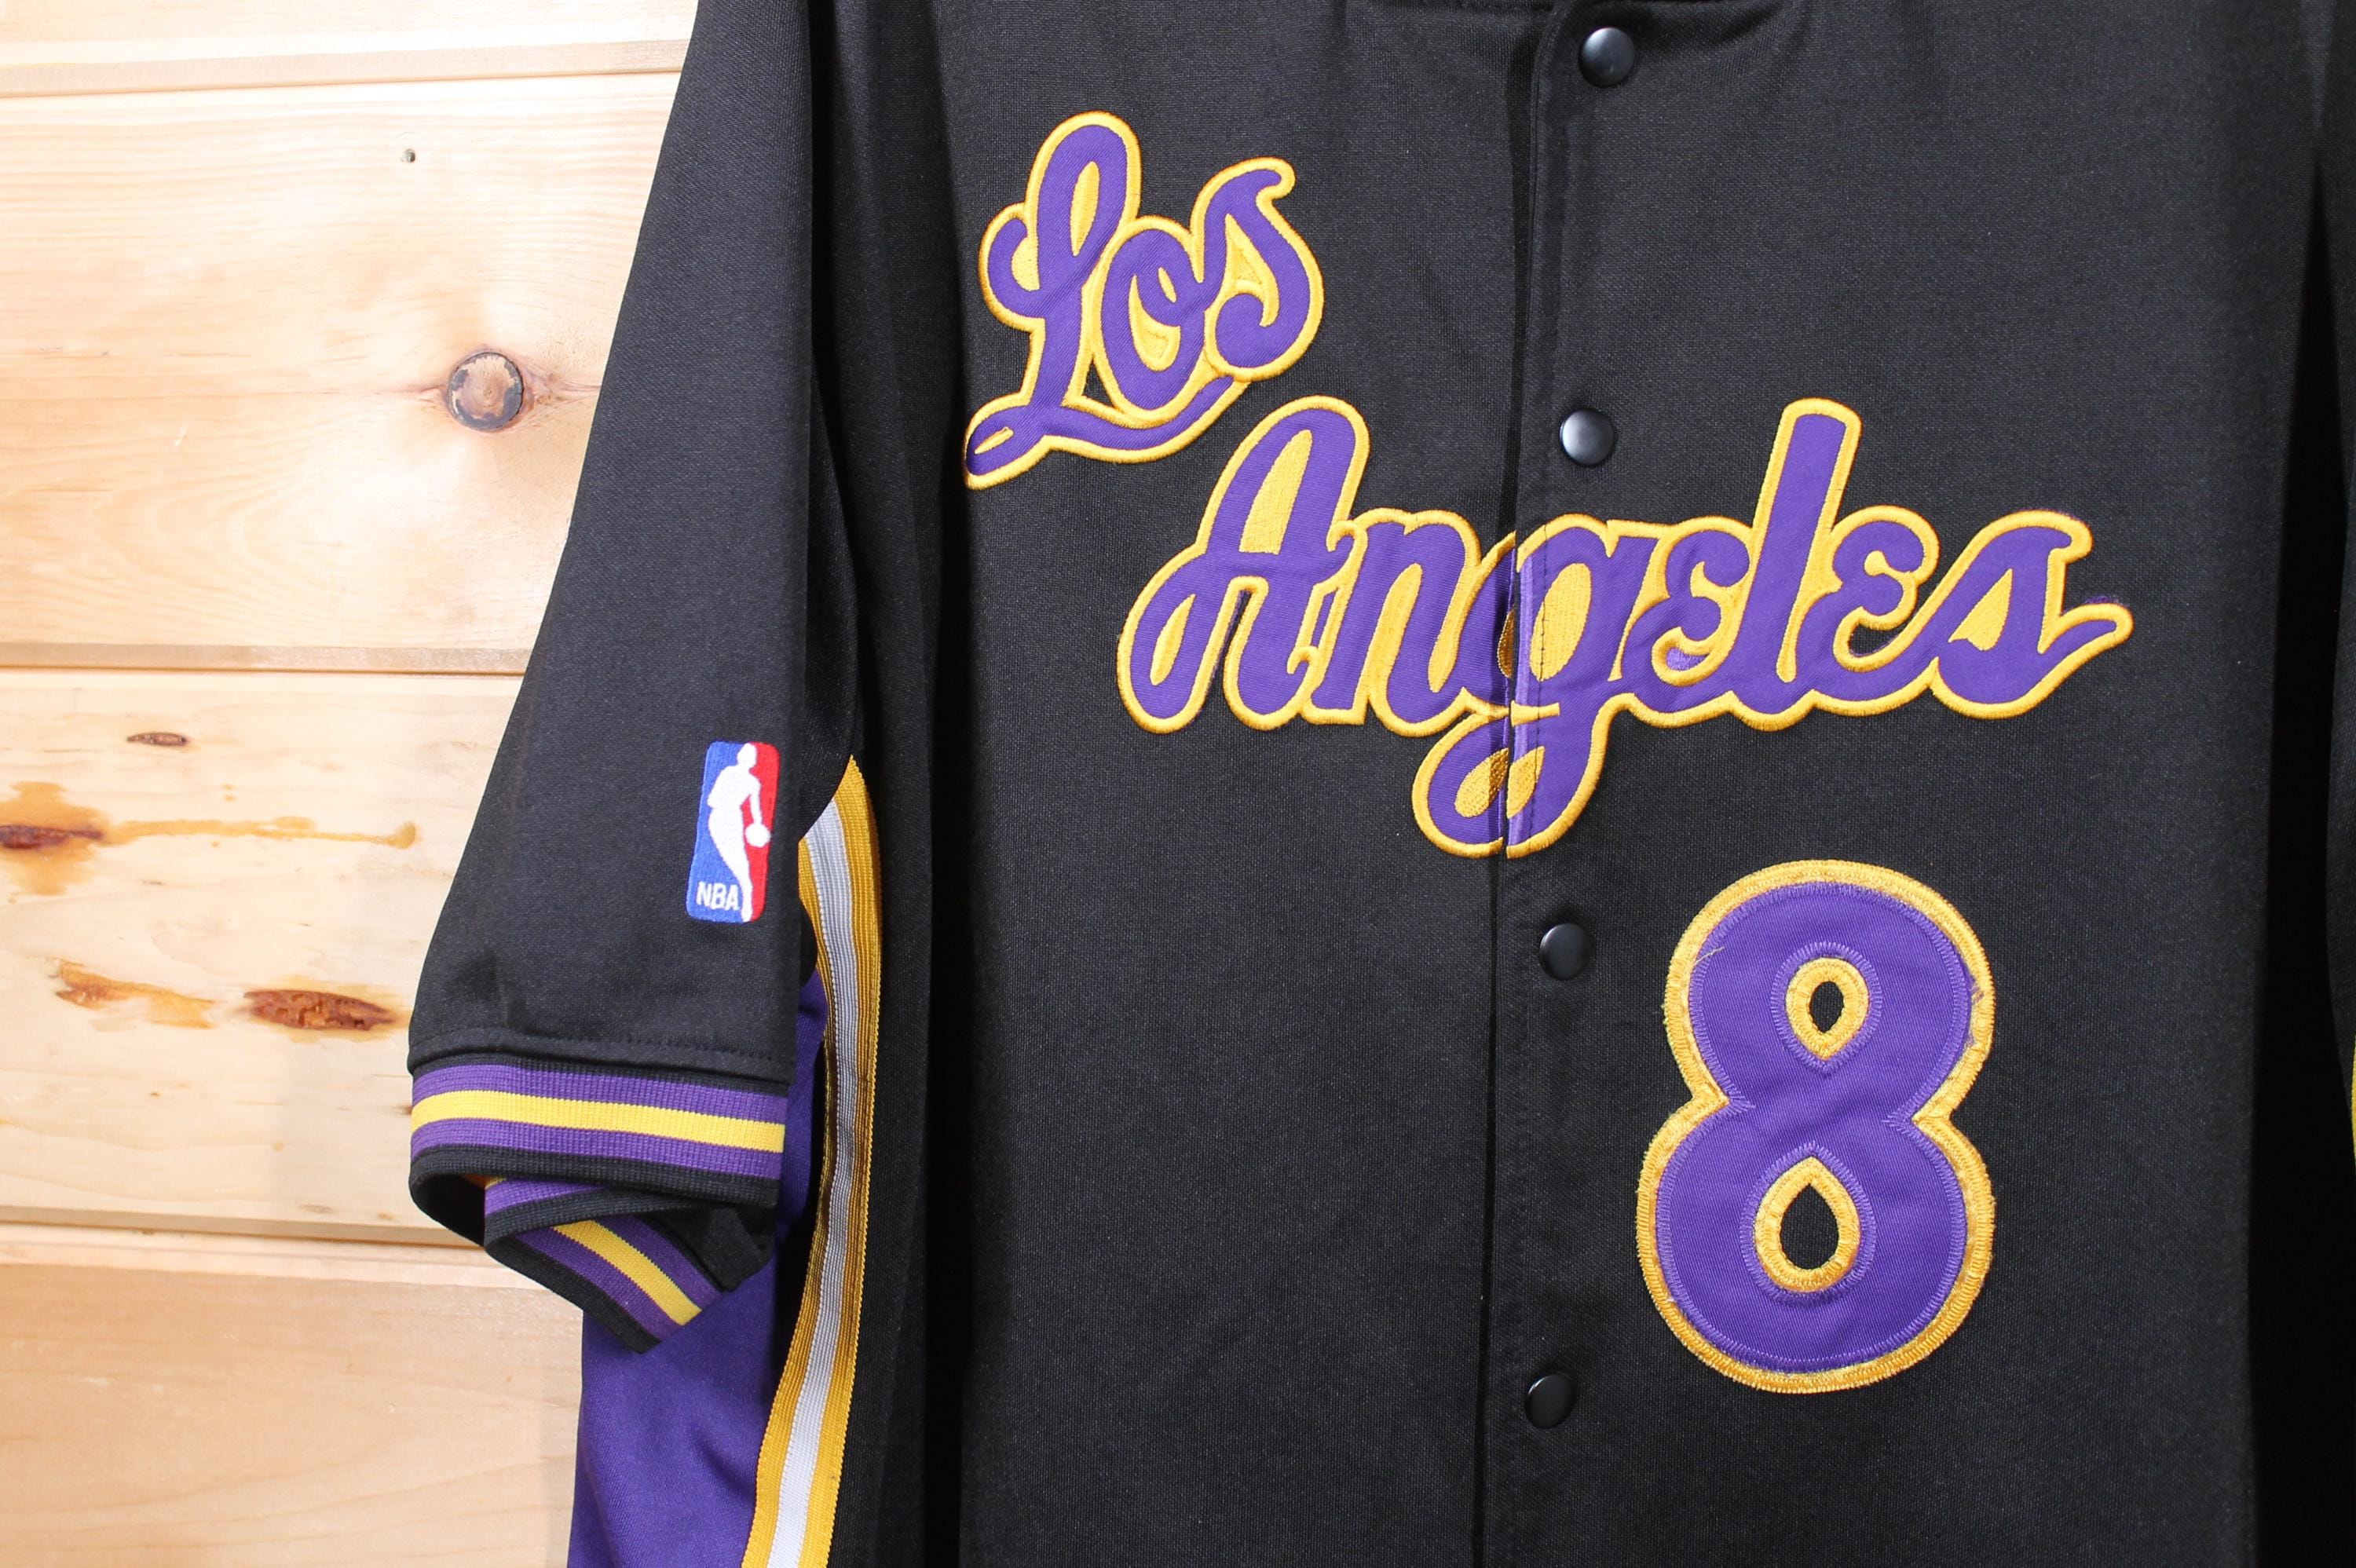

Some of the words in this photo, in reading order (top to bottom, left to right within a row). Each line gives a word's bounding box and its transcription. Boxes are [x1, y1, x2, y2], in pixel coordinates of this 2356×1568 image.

[965, 111, 1324, 491] Los
[1116, 395, 2133, 858] Angeles
[696, 880, 741, 911] NBA
[1636, 861, 1996, 1394] 8
